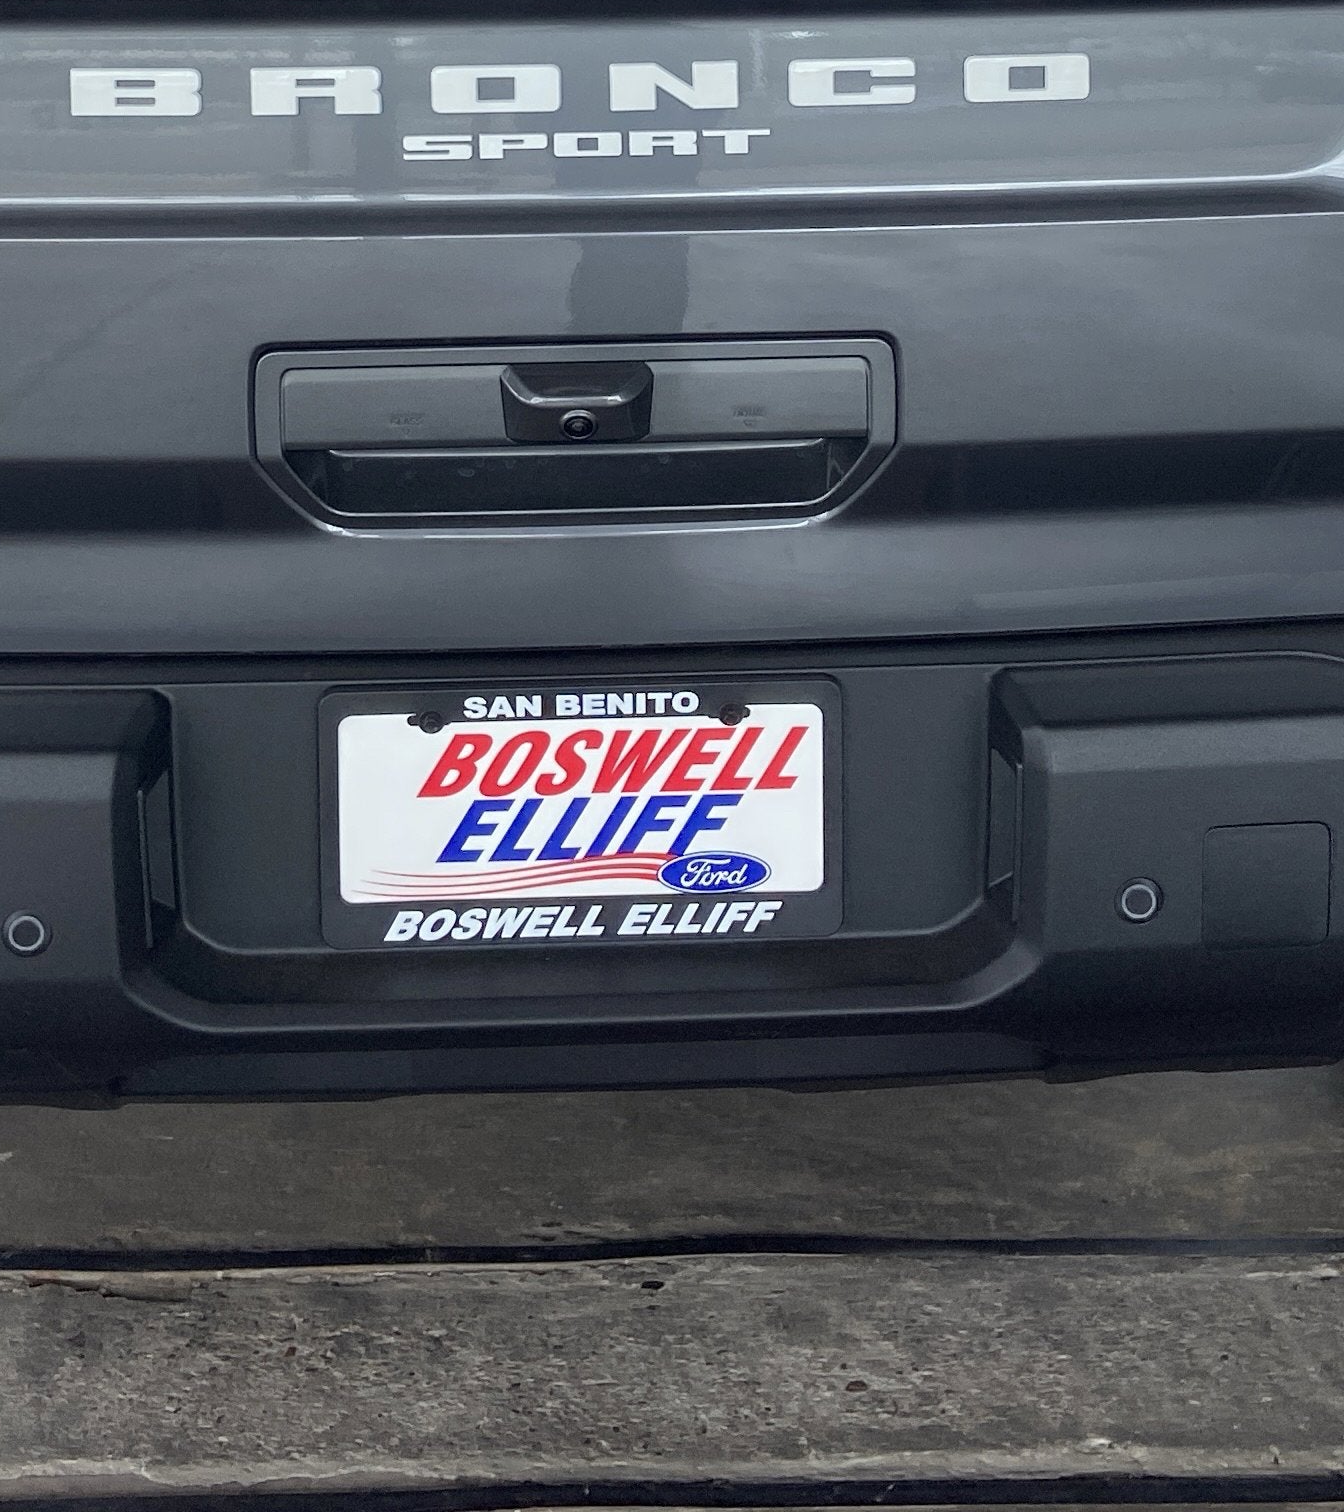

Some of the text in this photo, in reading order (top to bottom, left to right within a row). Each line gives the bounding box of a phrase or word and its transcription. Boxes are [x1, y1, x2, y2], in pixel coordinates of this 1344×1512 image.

[68, 51, 1092, 118] BRONCO
[402, 128, 771, 162] SPORT
[463, 691, 701, 720] SAN BENITO
[417, 725, 810, 799] BOSWELL
[435, 793, 745, 864] ELLIFF
[679, 858, 749, 888] Ford
[384, 900, 783, 943] BOSWELL ELLIFF
